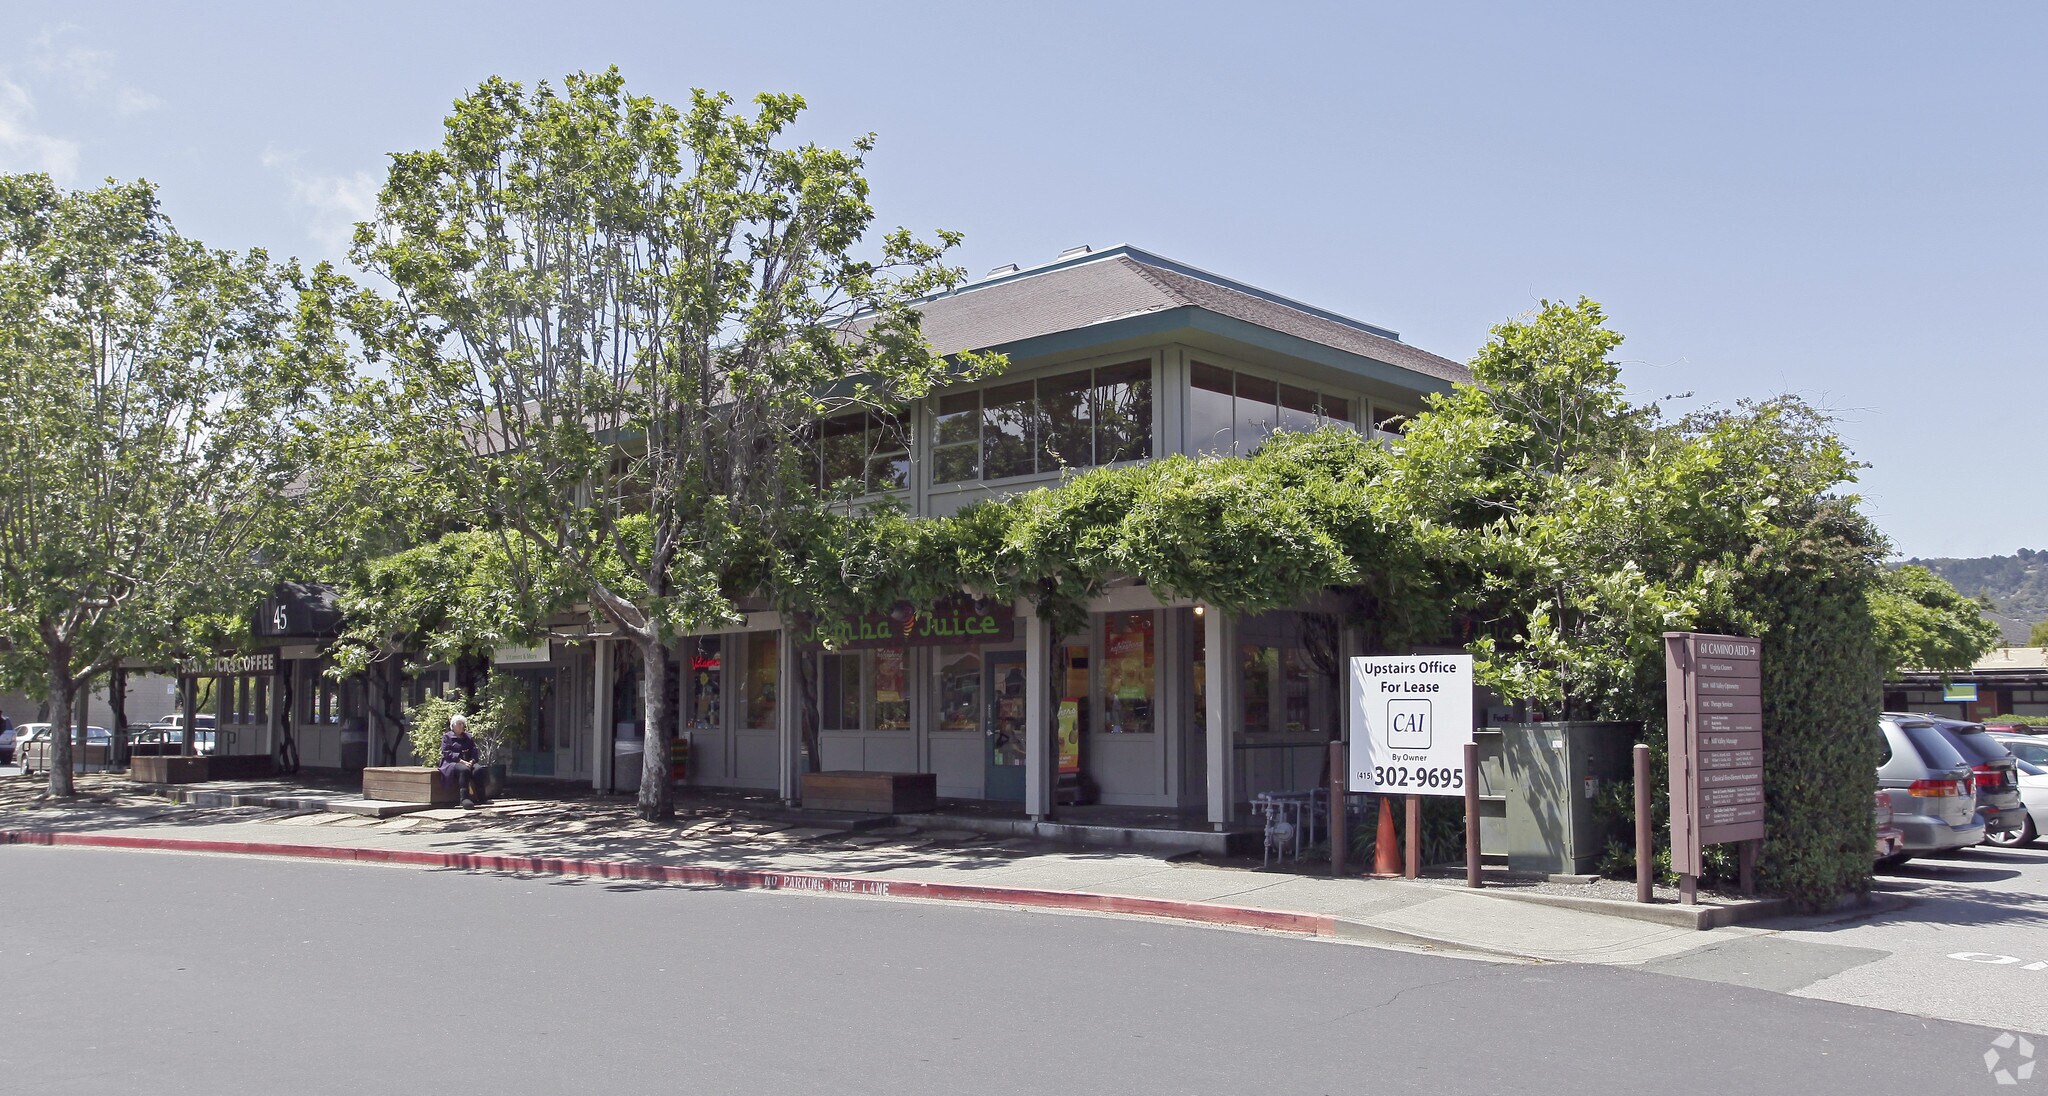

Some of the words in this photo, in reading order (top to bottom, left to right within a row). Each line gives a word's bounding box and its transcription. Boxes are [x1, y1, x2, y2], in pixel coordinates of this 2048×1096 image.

[273, 604, 287, 630] 45
[919, 609, 1000, 637] Juice
[1700, 643, 1707, 654] 61
[1708, 643, 1734, 656] CAMINO
[1735, 646, 1749, 656] ALTO
[181, 656, 236, 674] STACKS
[1364, 662, 1416, 677] Upstairs
[1418, 661, 1457, 674] Office
[1381, 681, 1401, 693] For
[1404, 681, 1440, 693] Lease
[1393, 713, 1426, 733] CAI
[1392, 754, 1401, 762] By
[1403, 753, 1428, 762] Owner
[1356, 771, 1373, 780] (415)
[1374, 766, 1464, 789] 302-9695
[764, 875, 778, 886] NO
[783, 876, 825, 890] PARKING
[832, 879, 855, 893] FIRE
[862, 882, 890, 896] LANE
